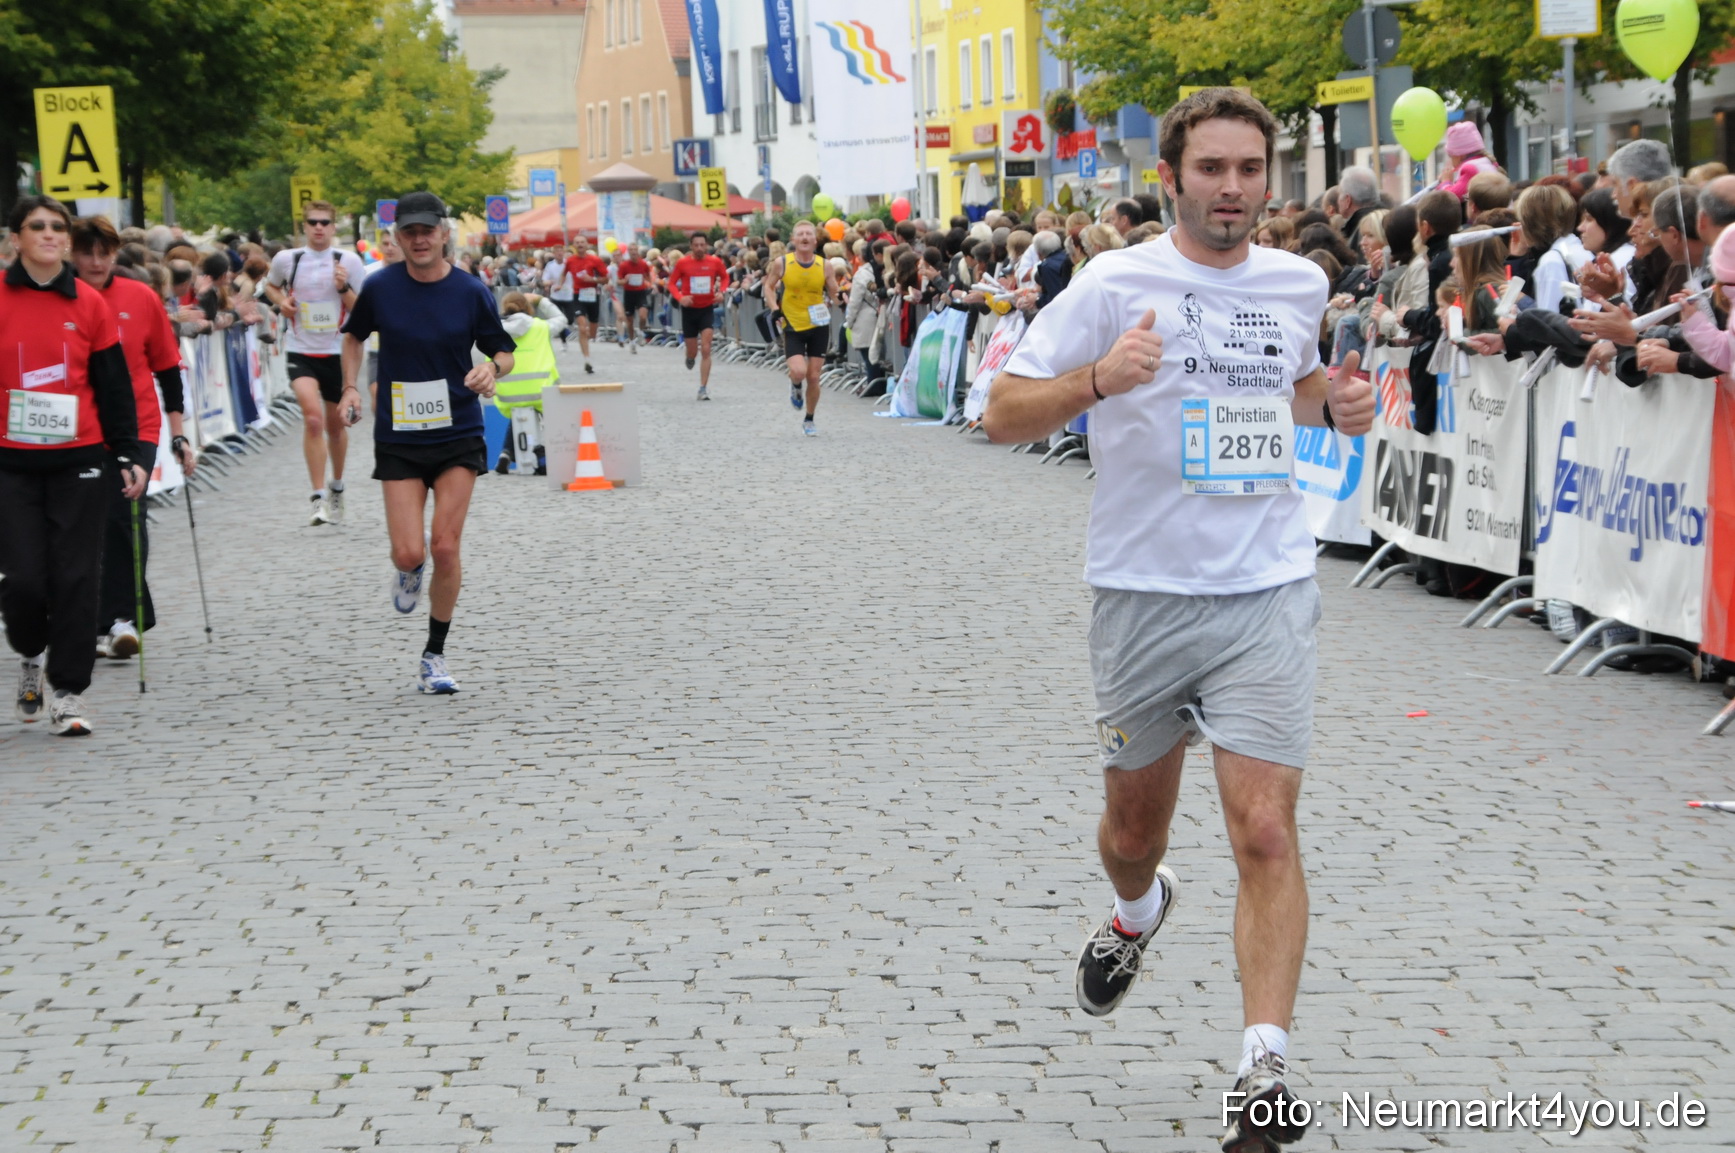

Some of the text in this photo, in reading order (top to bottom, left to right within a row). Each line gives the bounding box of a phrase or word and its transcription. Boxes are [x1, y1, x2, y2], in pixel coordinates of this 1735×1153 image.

[1331, 84, 1366, 97] Toiletten
[44, 91, 103, 113] Block
[59, 121, 101, 175] A
[1081, 151, 1093, 176] P
[701, 169, 723, 178] Block
[707, 180, 721, 201] B
[488, 221, 508, 231] TAXI
[1229, 329, 1283, 341] 21.09.2008
[1184, 357, 1284, 376] 9. Neumarkter
[1227, 374, 1284, 389] Stadtlauf
[27, 398, 52, 408] Maria
[408, 400, 445, 416] 1005
[27, 413, 70, 429] 5054
[1216, 405, 1277, 424] Christian
[1190, 434, 1198, 448] A
[1218, 434, 1283, 460] 2876
